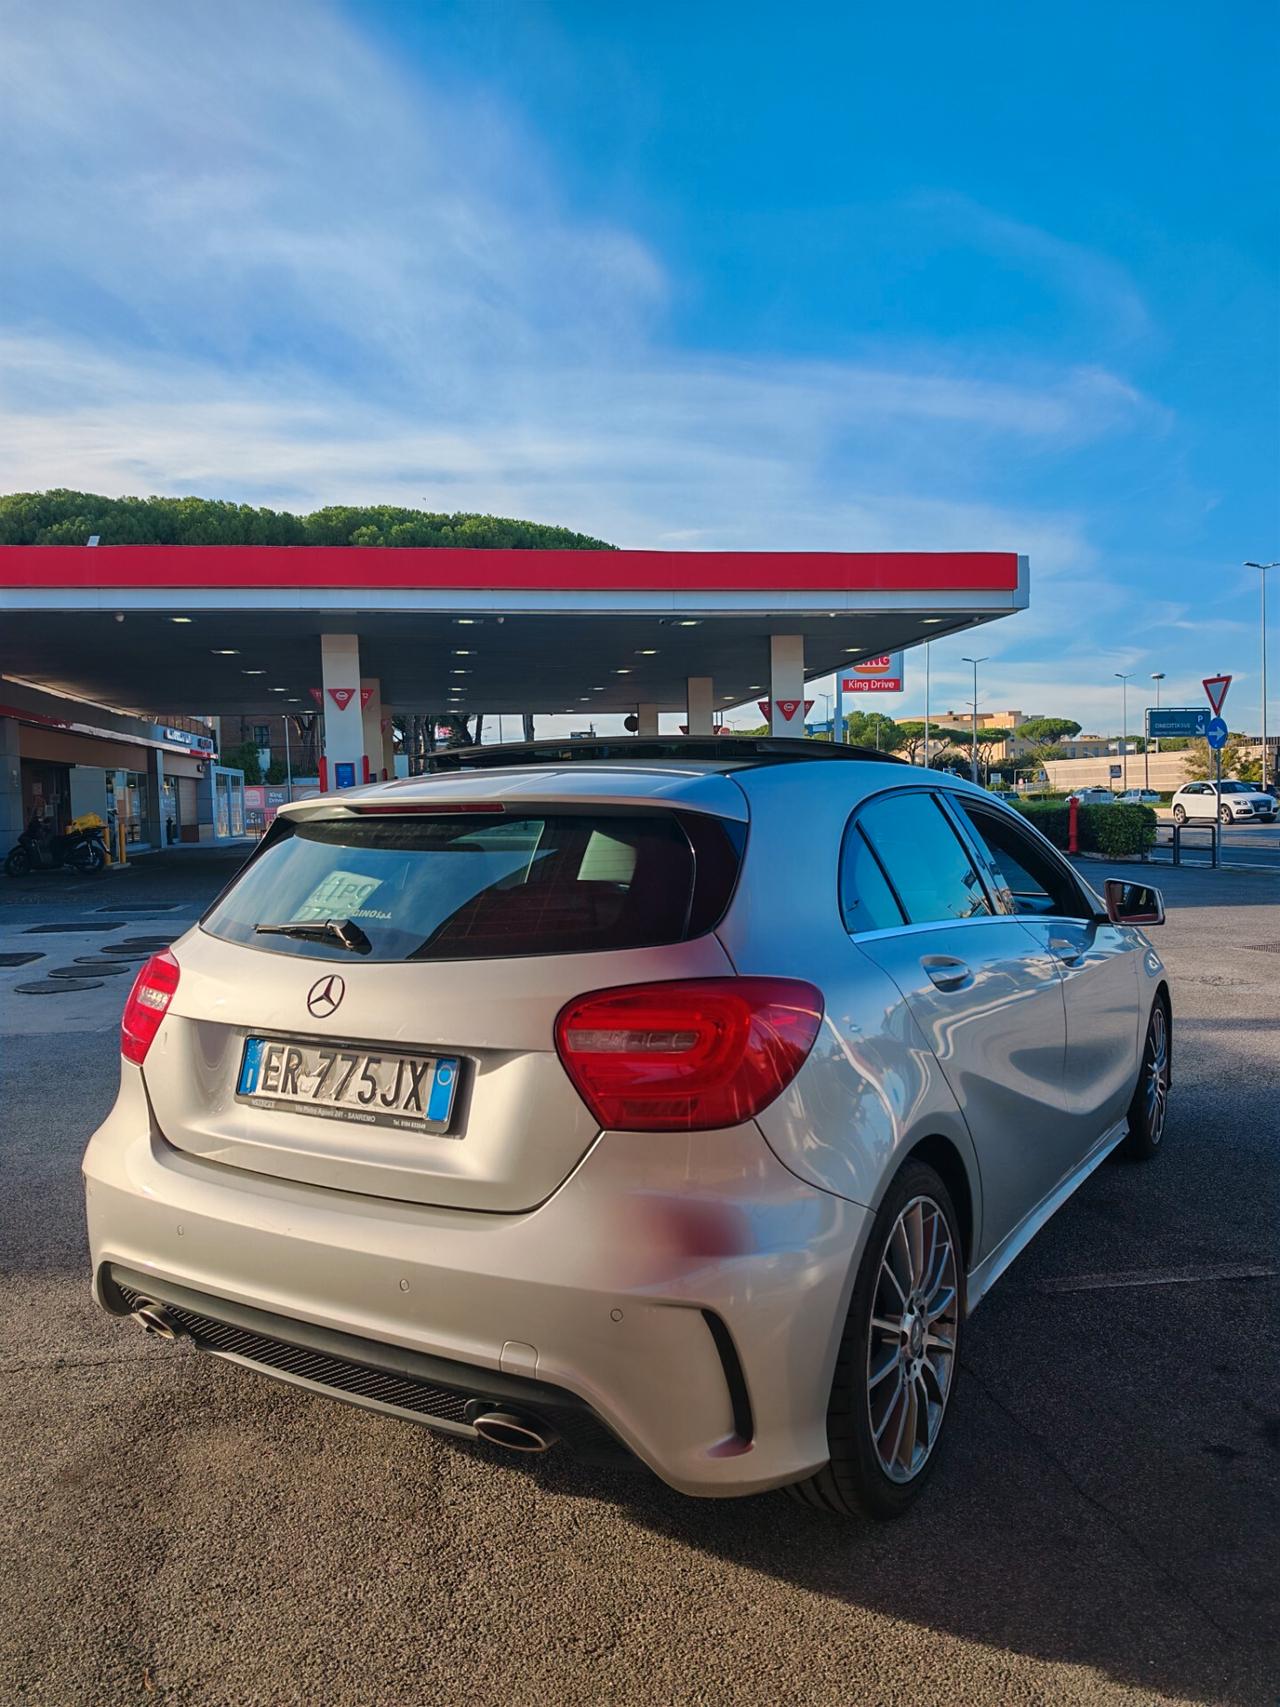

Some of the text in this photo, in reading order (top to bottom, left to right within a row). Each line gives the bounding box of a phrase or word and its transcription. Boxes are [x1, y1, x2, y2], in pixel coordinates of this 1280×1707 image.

[848, 680, 895, 691] King Drive
[1197, 715, 1204, 723] P
[246, 1068, 253, 1089] I
[262, 1046, 430, 1112] ER 775JX
[348, 1112, 376, 1123] SANREMO
